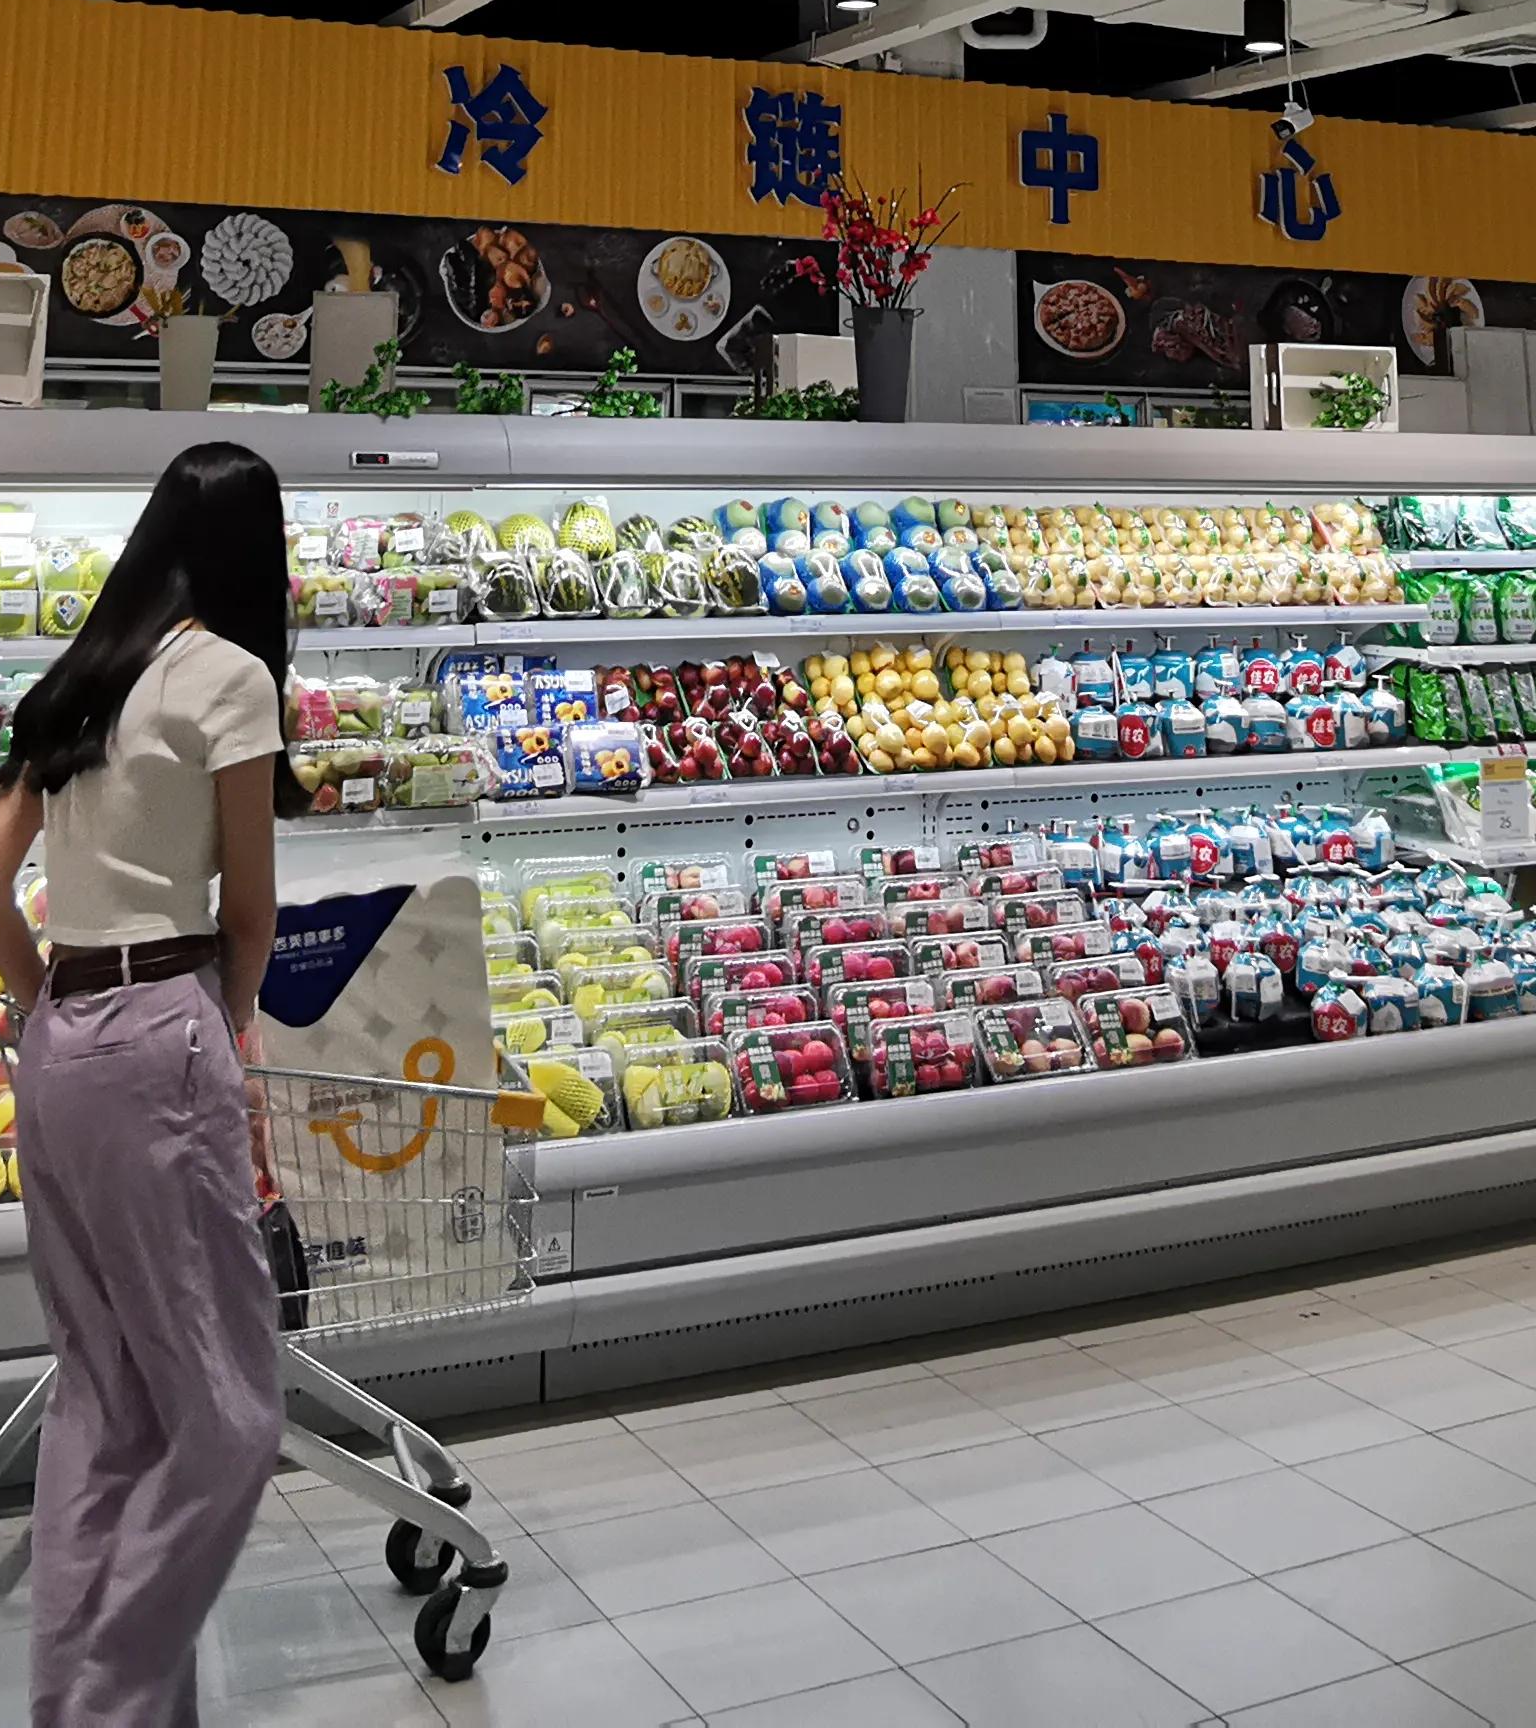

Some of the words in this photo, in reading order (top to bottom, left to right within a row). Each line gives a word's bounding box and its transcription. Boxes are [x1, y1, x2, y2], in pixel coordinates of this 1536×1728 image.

[434, 63, 1343, 242] 冷链中心
[1251, 669, 1276, 686] 佳农
[1120, 725, 1145, 744] 佳农
[1317, 1014, 1349, 1035] 佳农
